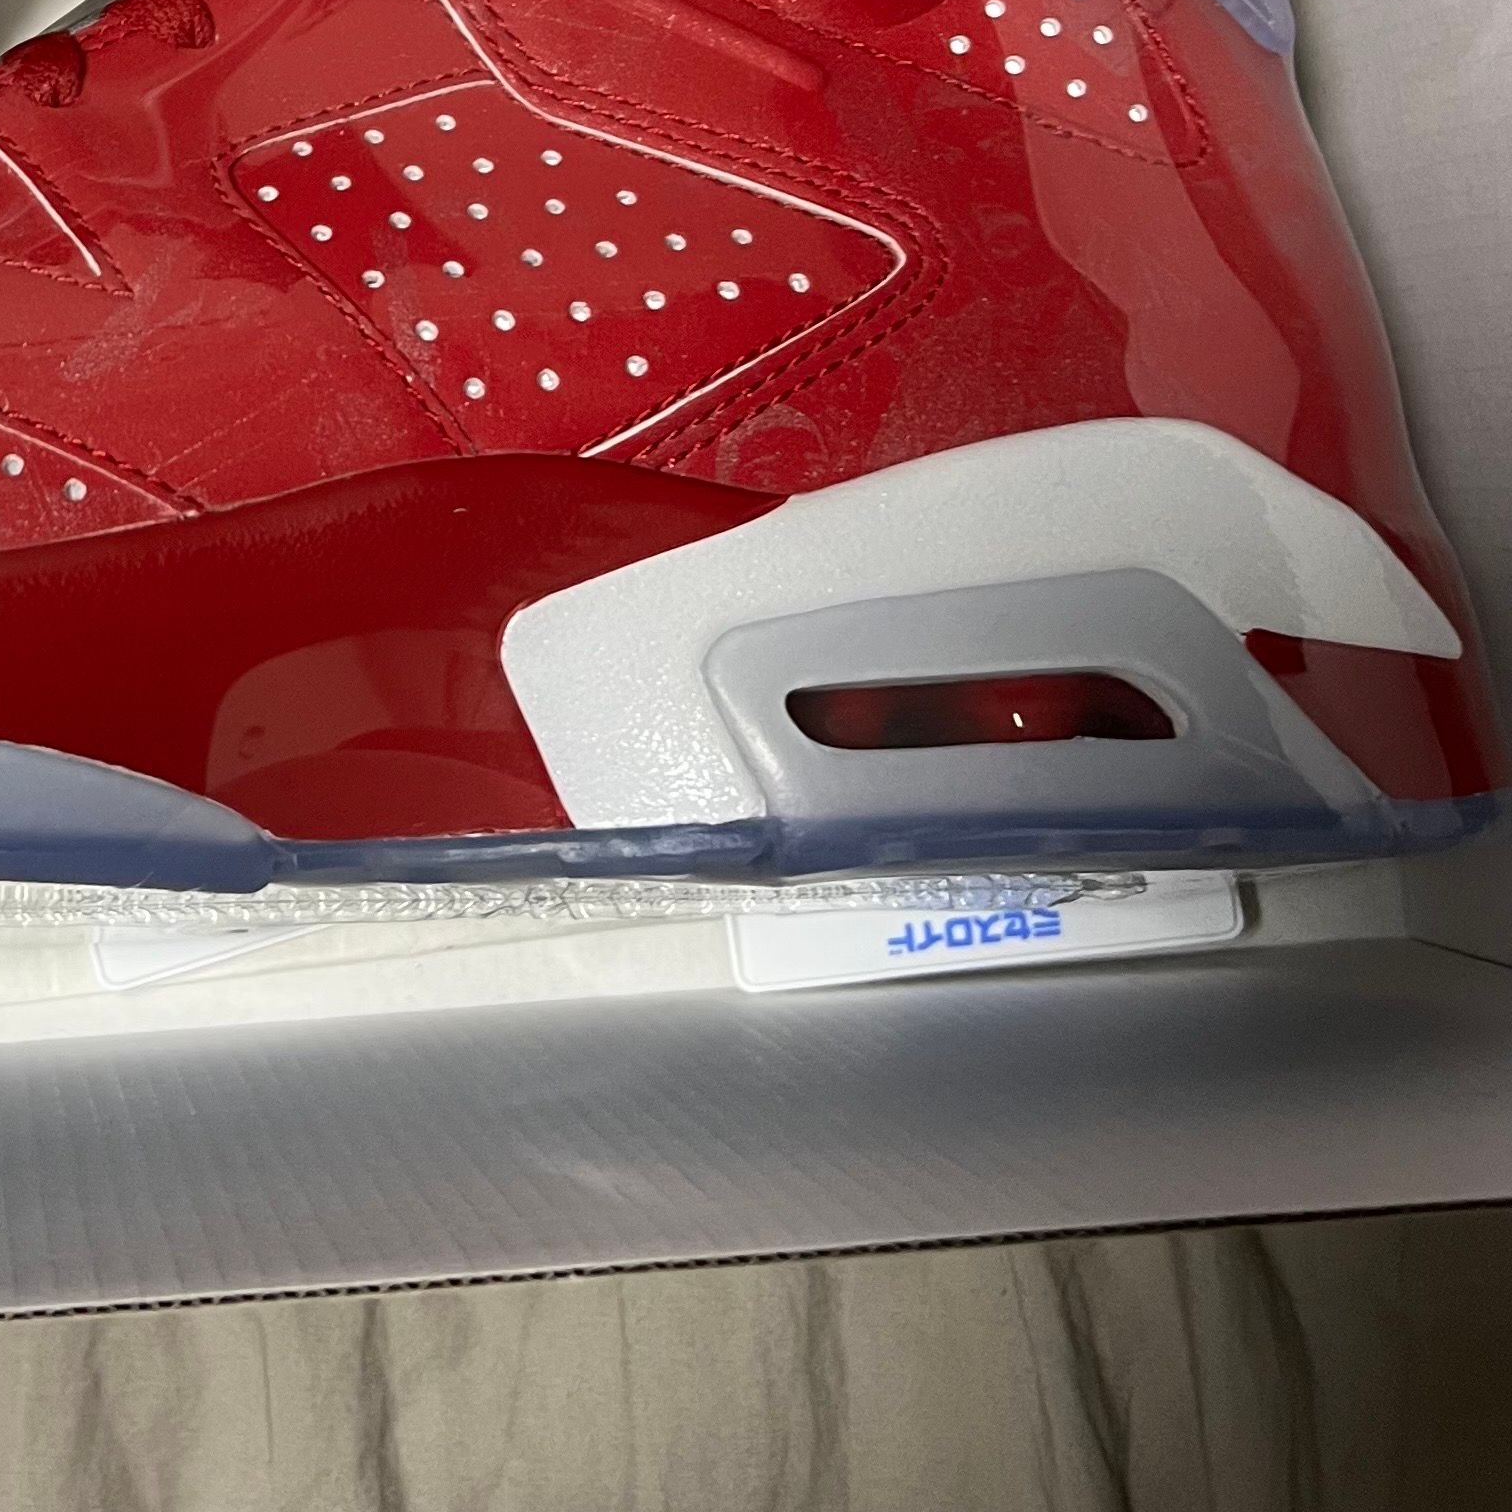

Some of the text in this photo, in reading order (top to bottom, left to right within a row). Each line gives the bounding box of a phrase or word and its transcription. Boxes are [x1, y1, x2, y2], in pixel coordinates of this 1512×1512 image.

[888, 909, 1061, 955] ミセスロイド
